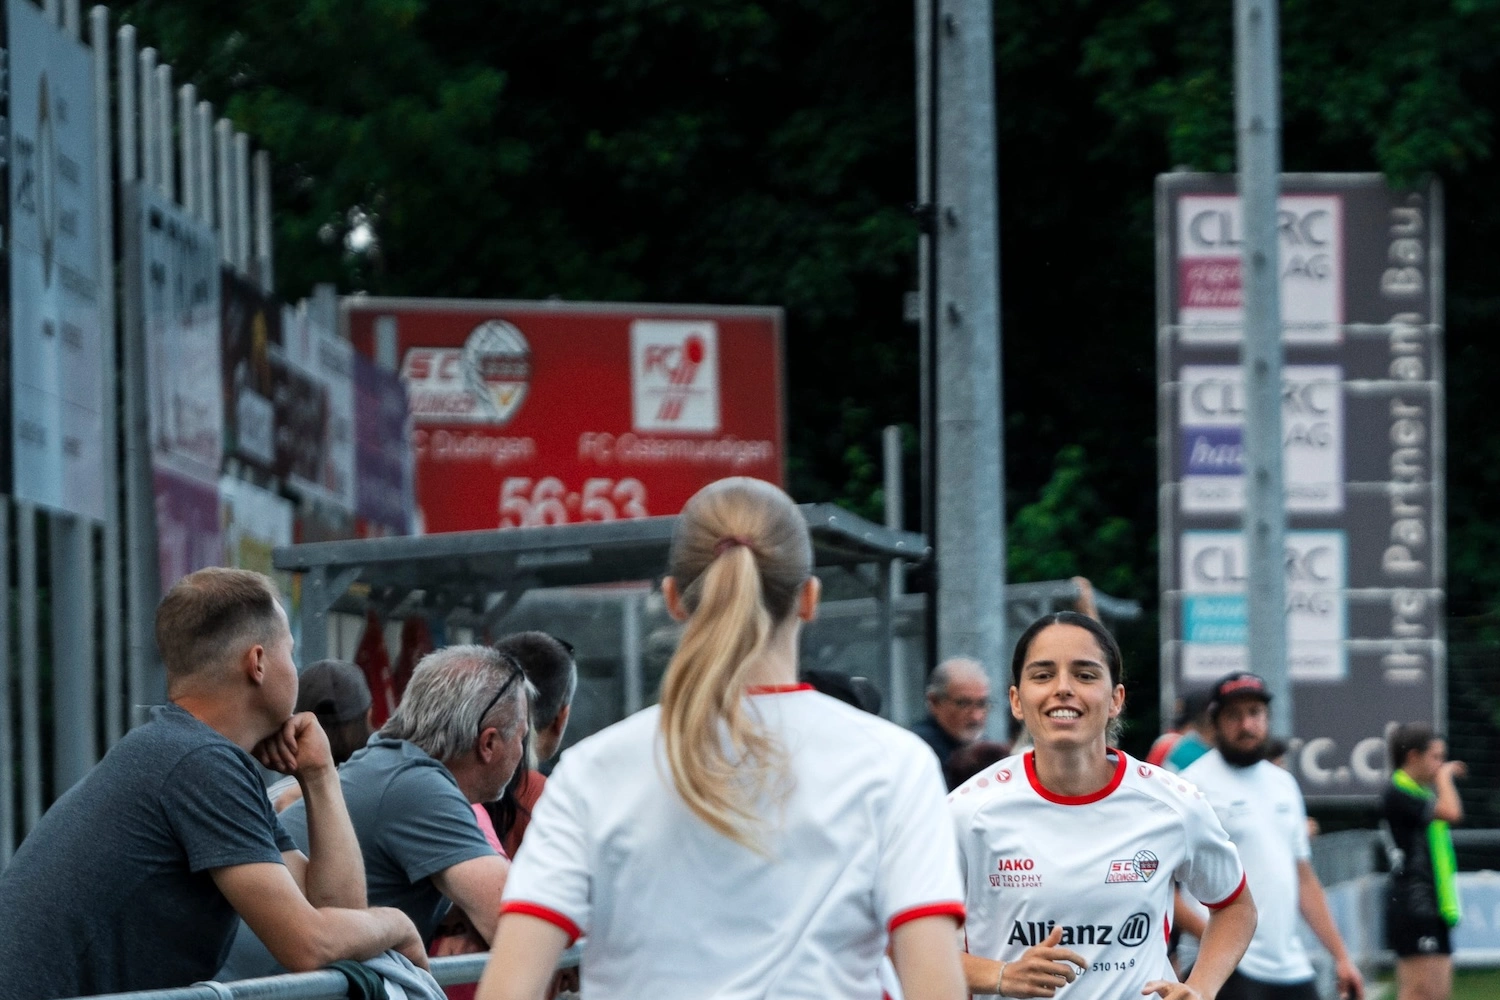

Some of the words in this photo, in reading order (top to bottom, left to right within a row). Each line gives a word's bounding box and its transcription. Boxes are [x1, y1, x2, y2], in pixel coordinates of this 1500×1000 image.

[1388, 311, 1425, 381] am
[578, 431, 615, 464] FC
[1381, 395, 1426, 574] Partner
[499, 476, 650, 527] 56:53
[998, 858, 1034, 871] JAKO
[1002, 874, 1042, 882] TROPHY
[1007, 920, 1113, 946] Allianz
[1092, 962, 1111, 972] 510
[1114, 962, 1126, 971] 14
